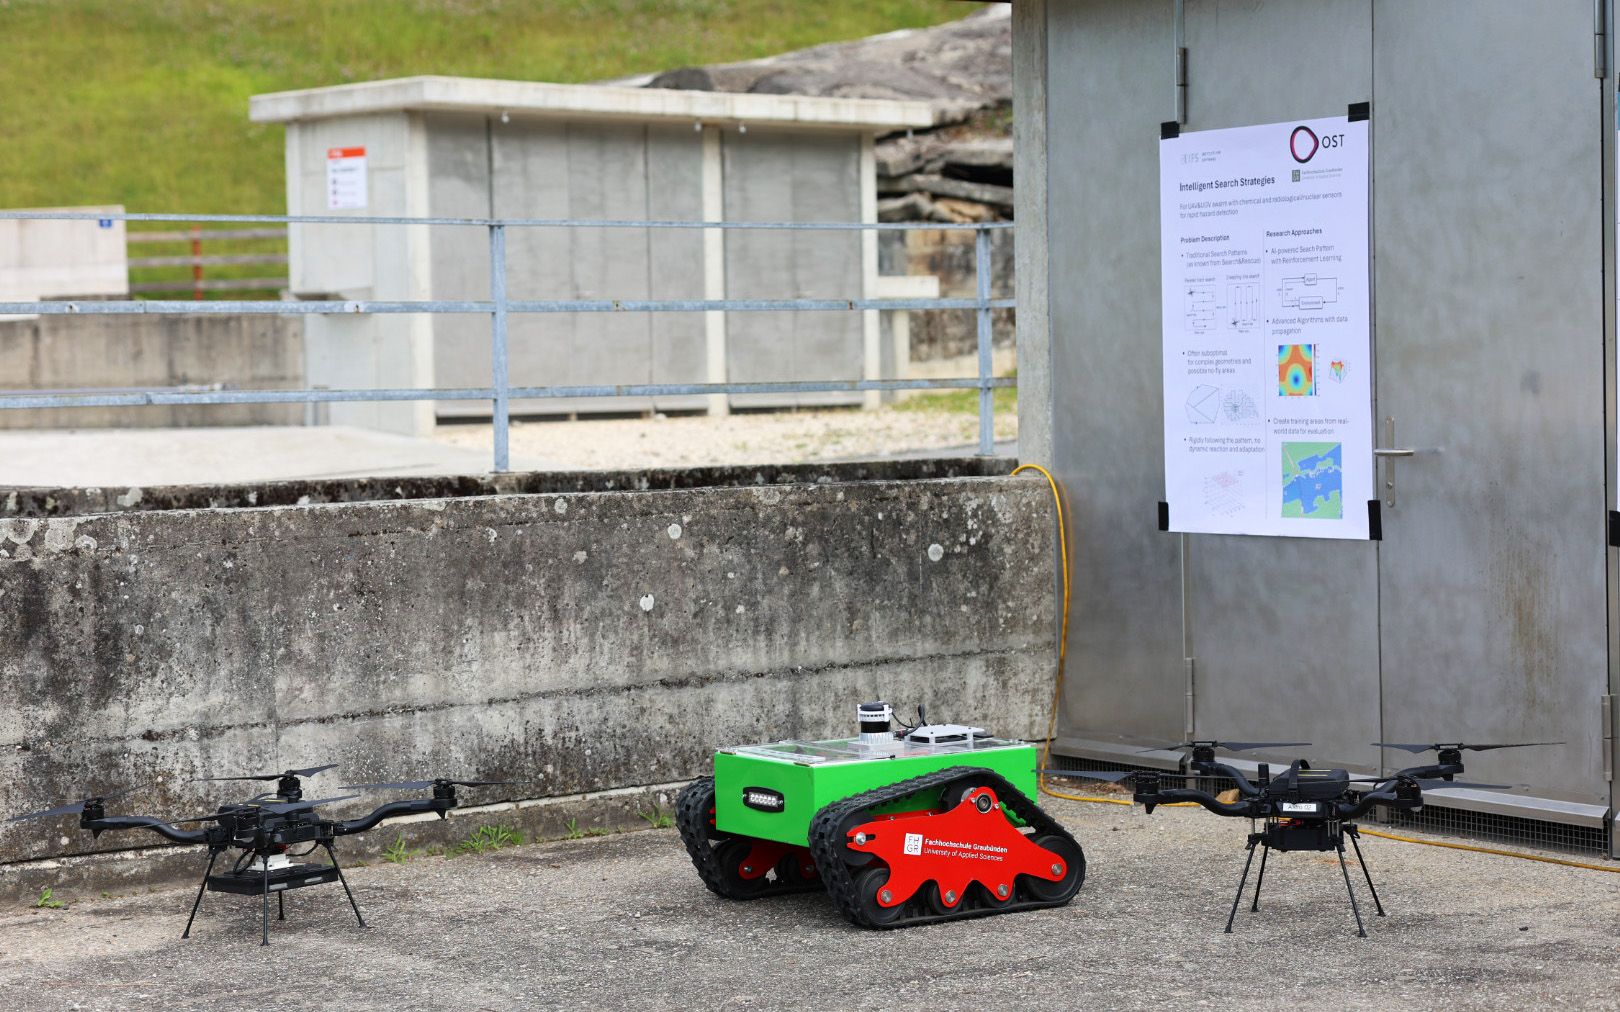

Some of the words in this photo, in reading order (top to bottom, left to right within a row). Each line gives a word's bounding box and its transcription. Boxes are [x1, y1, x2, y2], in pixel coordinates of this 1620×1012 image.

[1322, 134, 1344, 148] OST
[1180, 182, 1213, 192] Intelligent
[1214, 179, 1238, 188] Search
[1240, 176, 1275, 187] Strategies
[1266, 229, 1290, 238] Research
[1292, 228, 1322, 237] Approaches
[1282, 256, 1318, 264] Reinforcement
[1320, 254, 1342, 263] Learning
[1272, 317, 1296, 325] Advanced
[1297, 316, 1324, 325] Algorithms
[1290, 418, 1309, 426] training
[1205, 436, 1226, 444] following
[908, 836, 920, 844] FH
[906, 844, 919, 853] GR
[924, 838, 972, 850] Fachhochschule
[973, 843, 1008, 853] Graubünden
[924, 848, 950, 857] University
[980, 853, 1004, 862] Sciences
